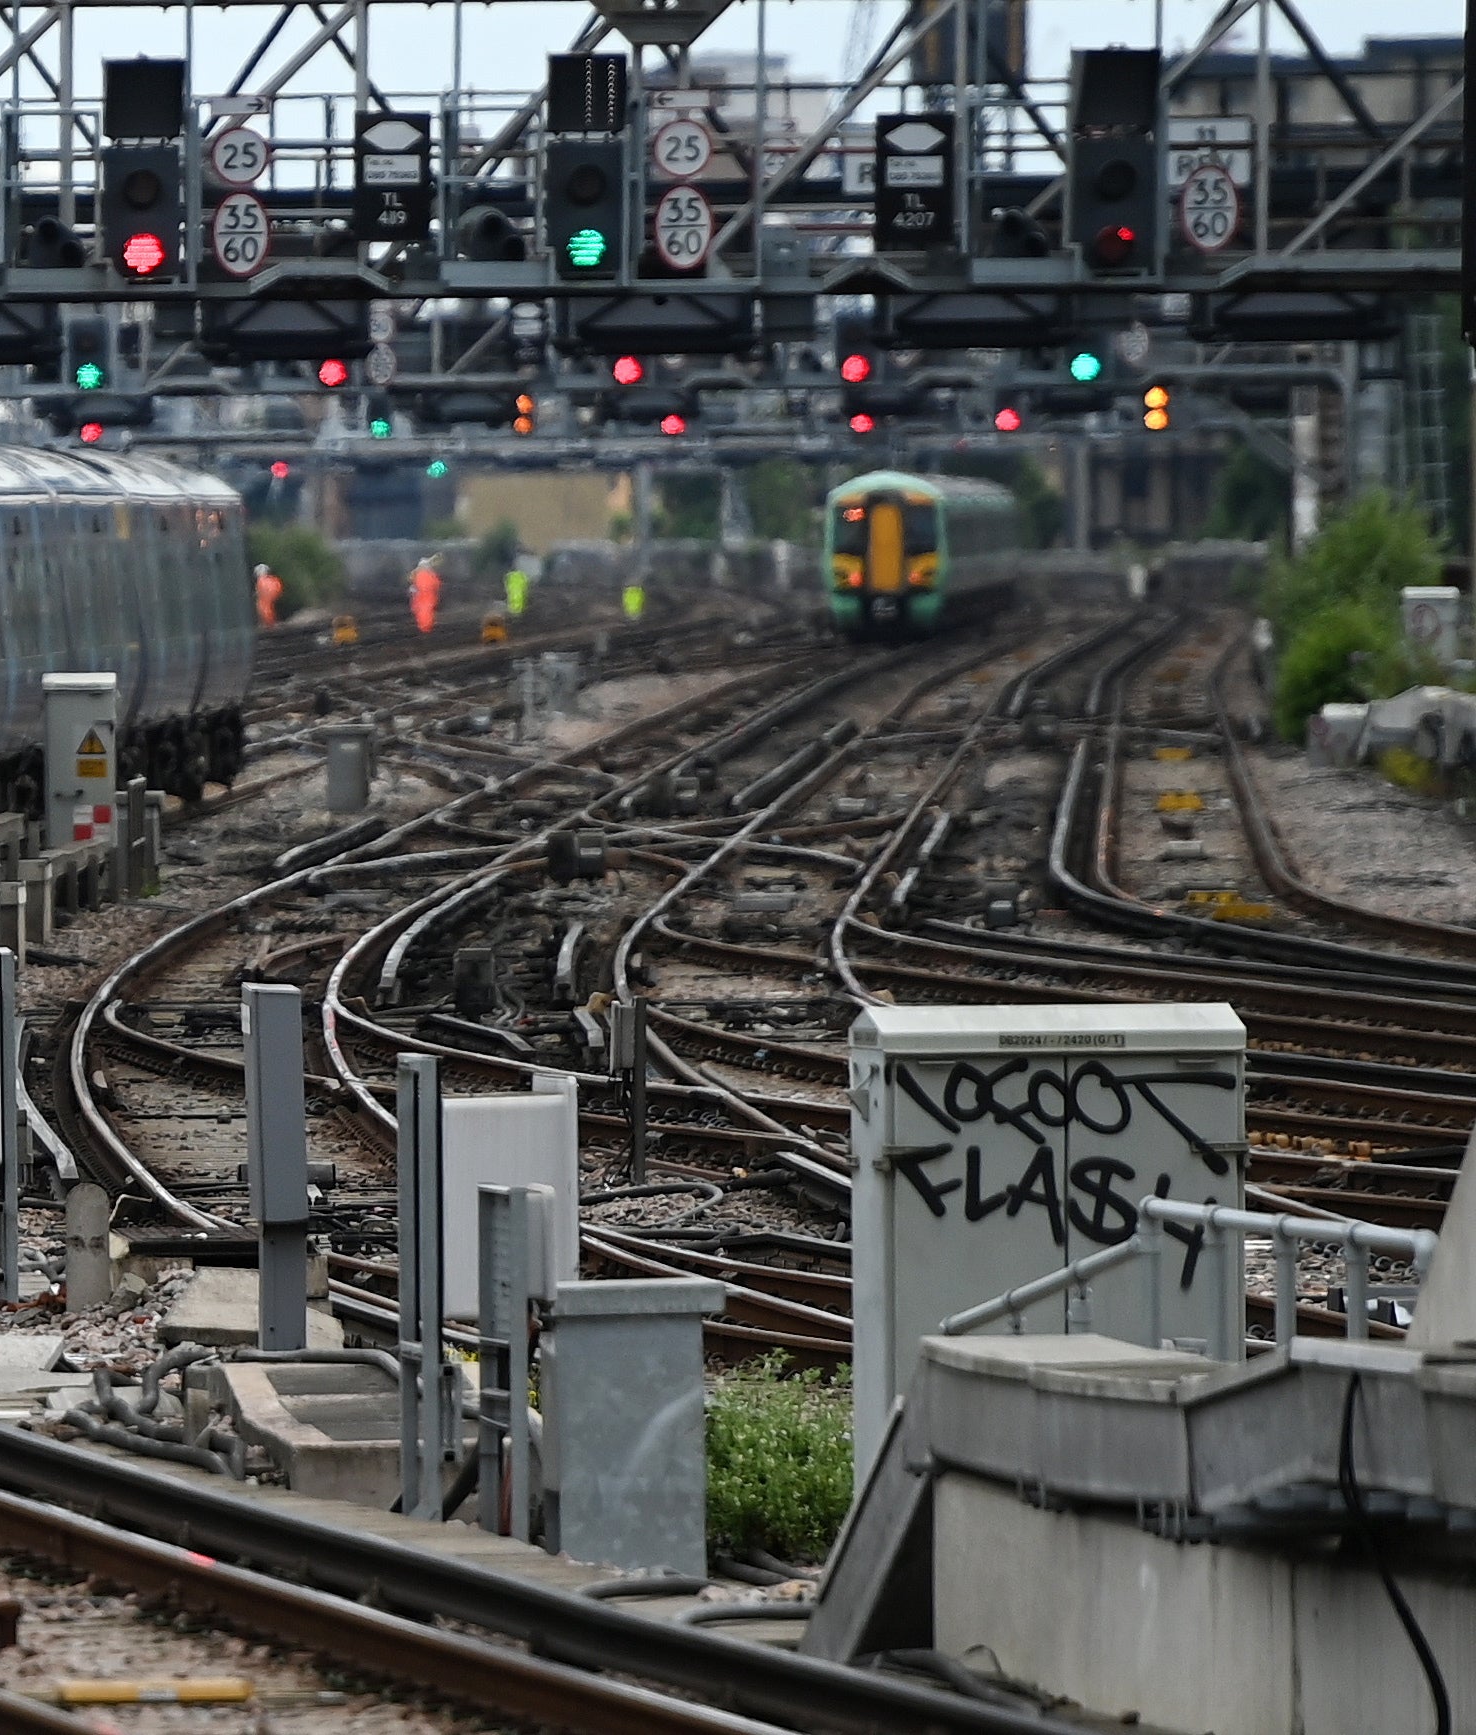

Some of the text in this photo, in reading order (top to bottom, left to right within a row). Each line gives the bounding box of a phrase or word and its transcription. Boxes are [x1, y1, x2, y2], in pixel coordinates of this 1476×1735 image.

[224, 142, 259, 169] 25
[665, 135, 701, 162] 25
[381, 191, 403, 207] TL
[1192, 178, 1228, 205] 35
[225, 204, 258, 229] 35
[667, 197, 702, 223] 35
[892, 211, 936, 227] 4207
[1193, 211, 1228, 238] 60
[223, 237, 259, 263] 60
[666, 229, 703, 256] 60
